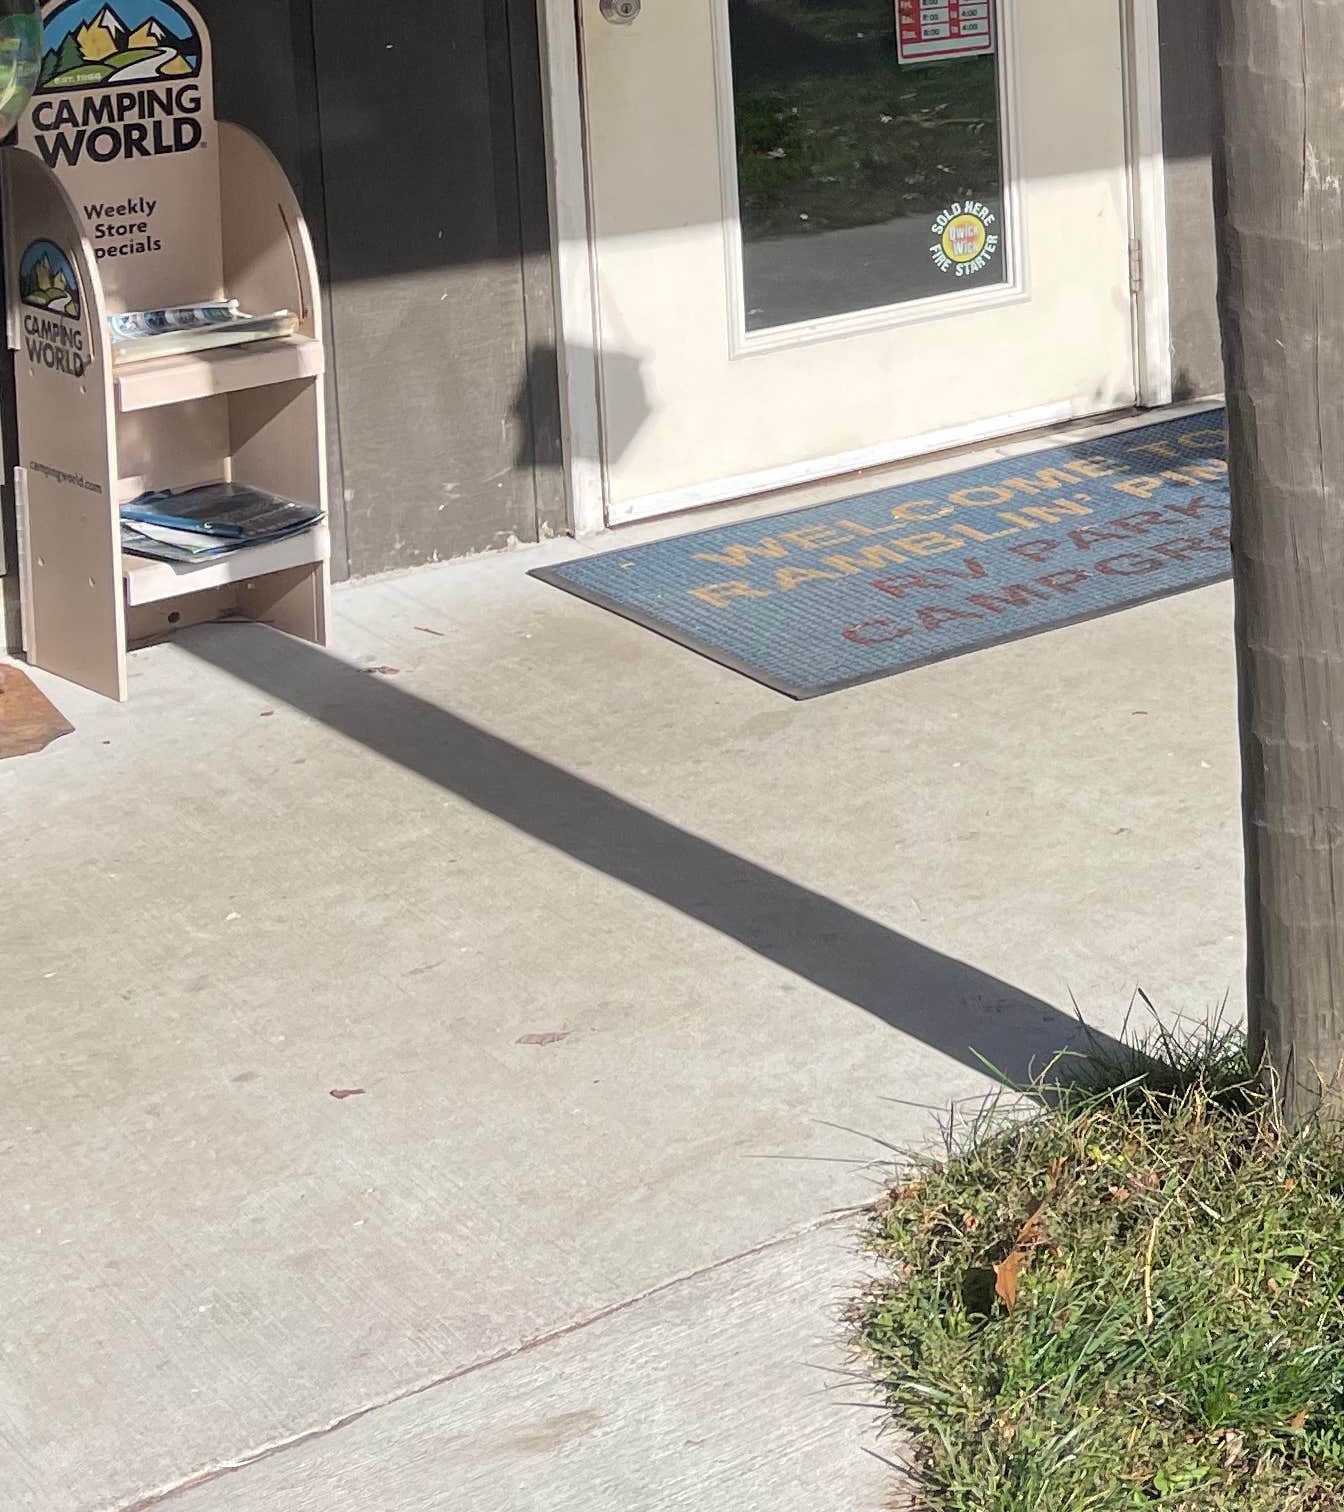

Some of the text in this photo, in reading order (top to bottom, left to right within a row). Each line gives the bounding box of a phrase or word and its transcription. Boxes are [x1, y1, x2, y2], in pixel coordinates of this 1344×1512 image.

[31, 84, 200, 131] CAMPING
[34, 117, 203, 169] WORLD
[84, 197, 157, 220] Weekly
[931, 200, 995, 235] SOLD HERE
[94, 235, 162, 262] pecials
[95, 222, 147, 239] Store
[929, 234, 998, 276] FIRE STARTER
[24, 315, 83, 351] CAMPING
[25, 336, 84, 377] WORLD
[693, 430, 1227, 567] WELCOME TO
[689, 459, 1230, 609] RAMBLIN' PIN
[871, 496, 1231, 599] RV PARK
